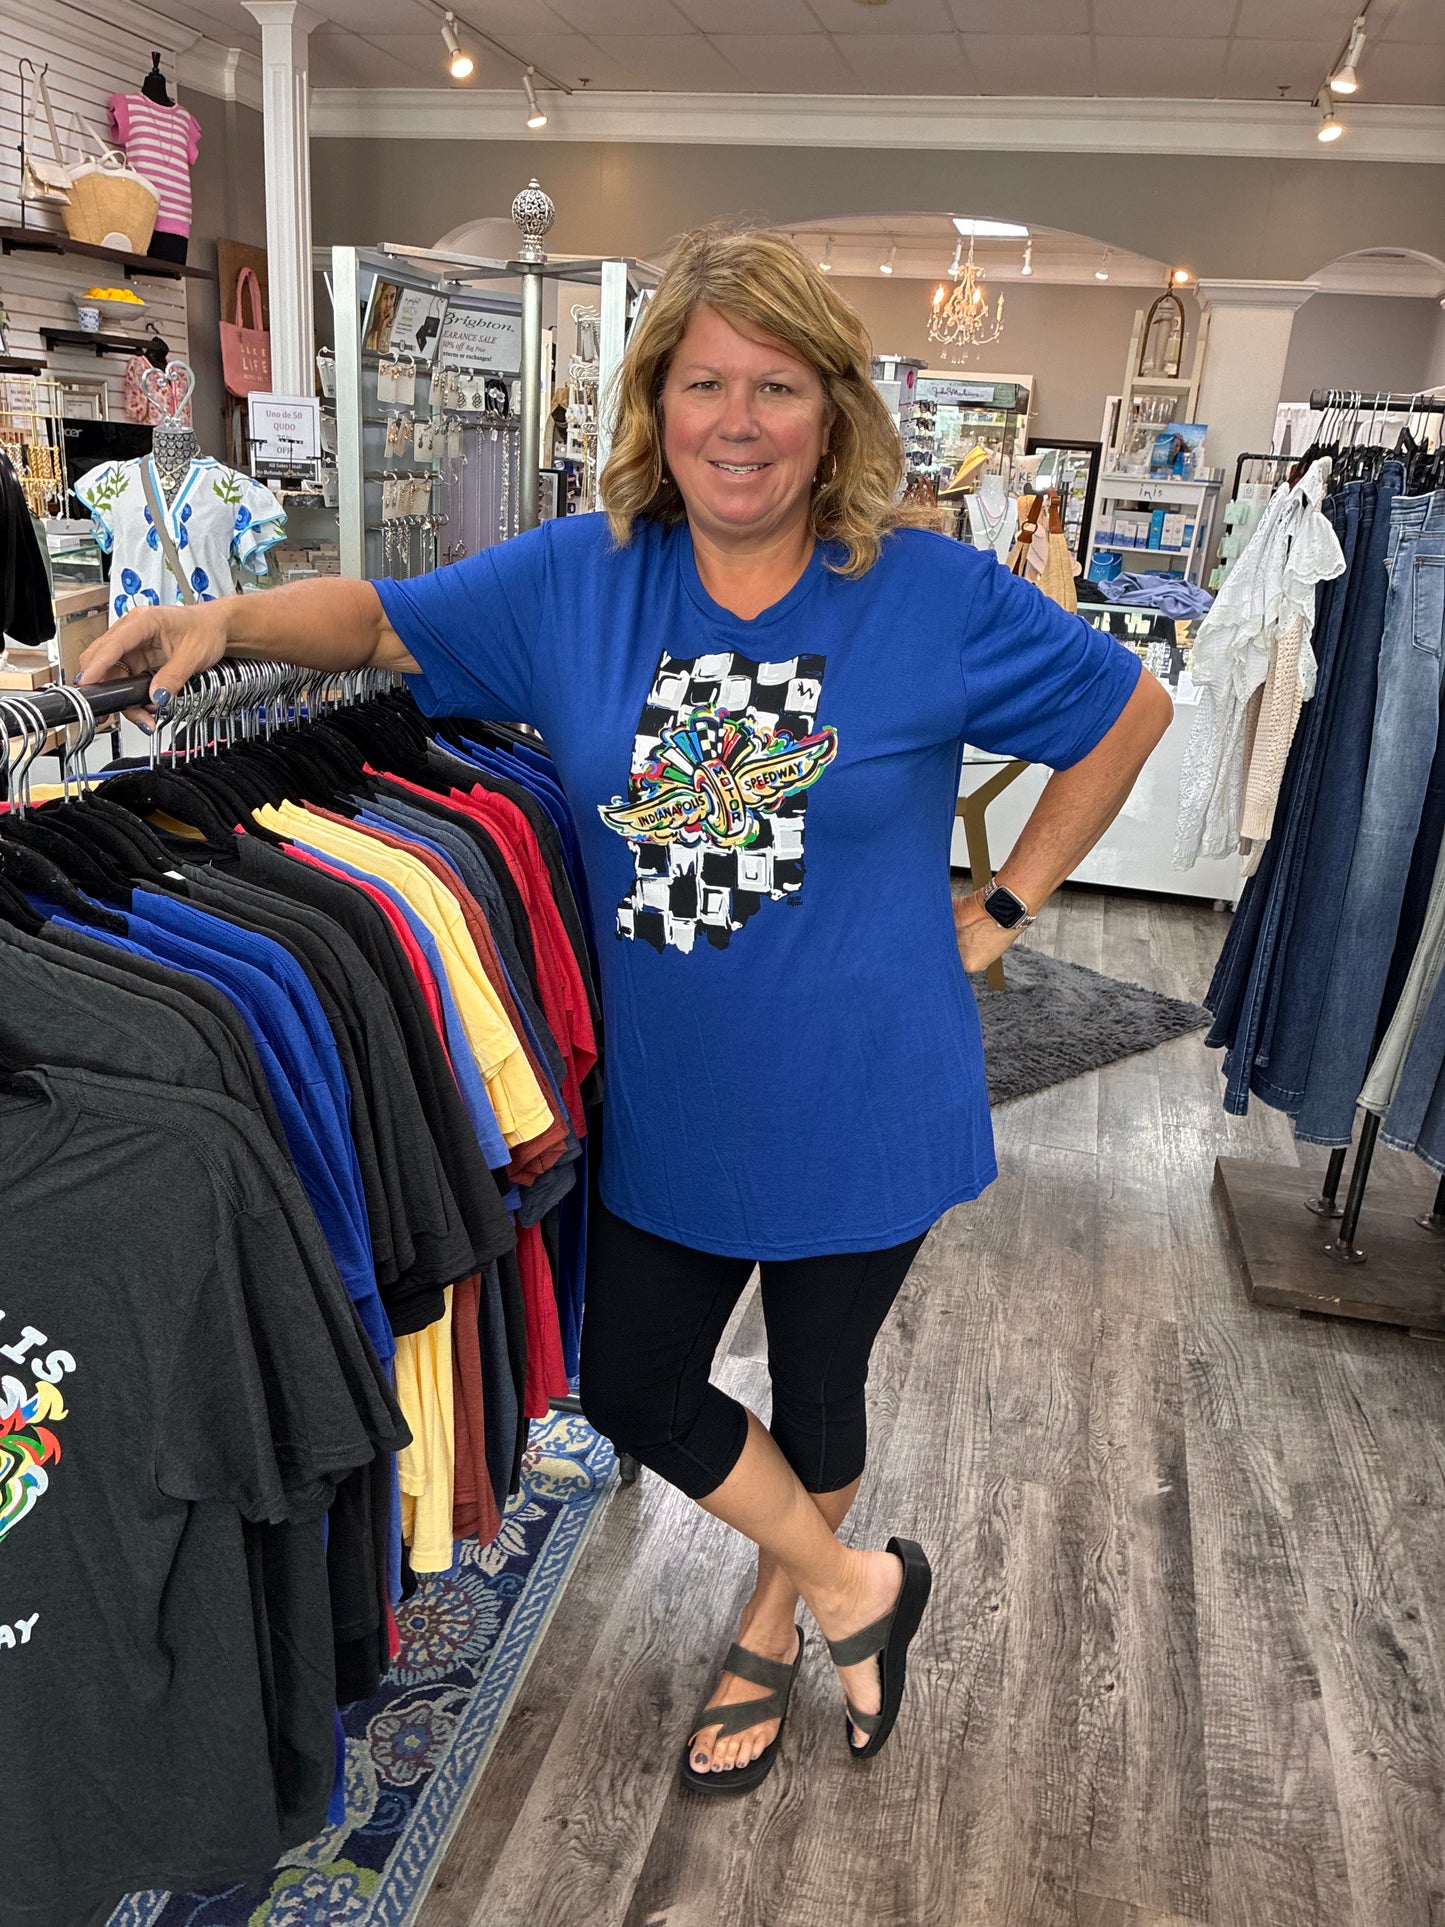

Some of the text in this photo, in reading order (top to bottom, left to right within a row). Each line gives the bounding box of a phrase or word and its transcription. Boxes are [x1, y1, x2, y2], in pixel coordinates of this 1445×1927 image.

[444, 311, 515, 332] Brighton
[455, 342, 466, 351] off
[478, 335, 497, 344] SALE
[266, 410, 280, 418] Uno
[282, 410, 291, 418] de
[273, 422, 296, 431] QUDO
[744, 763, 801, 791] SPEEDWAY
[714, 766, 742, 823] MOTOR
[637, 795, 706, 827] INDIANAPOLIS
[0, 1310, 76, 1384] IS
